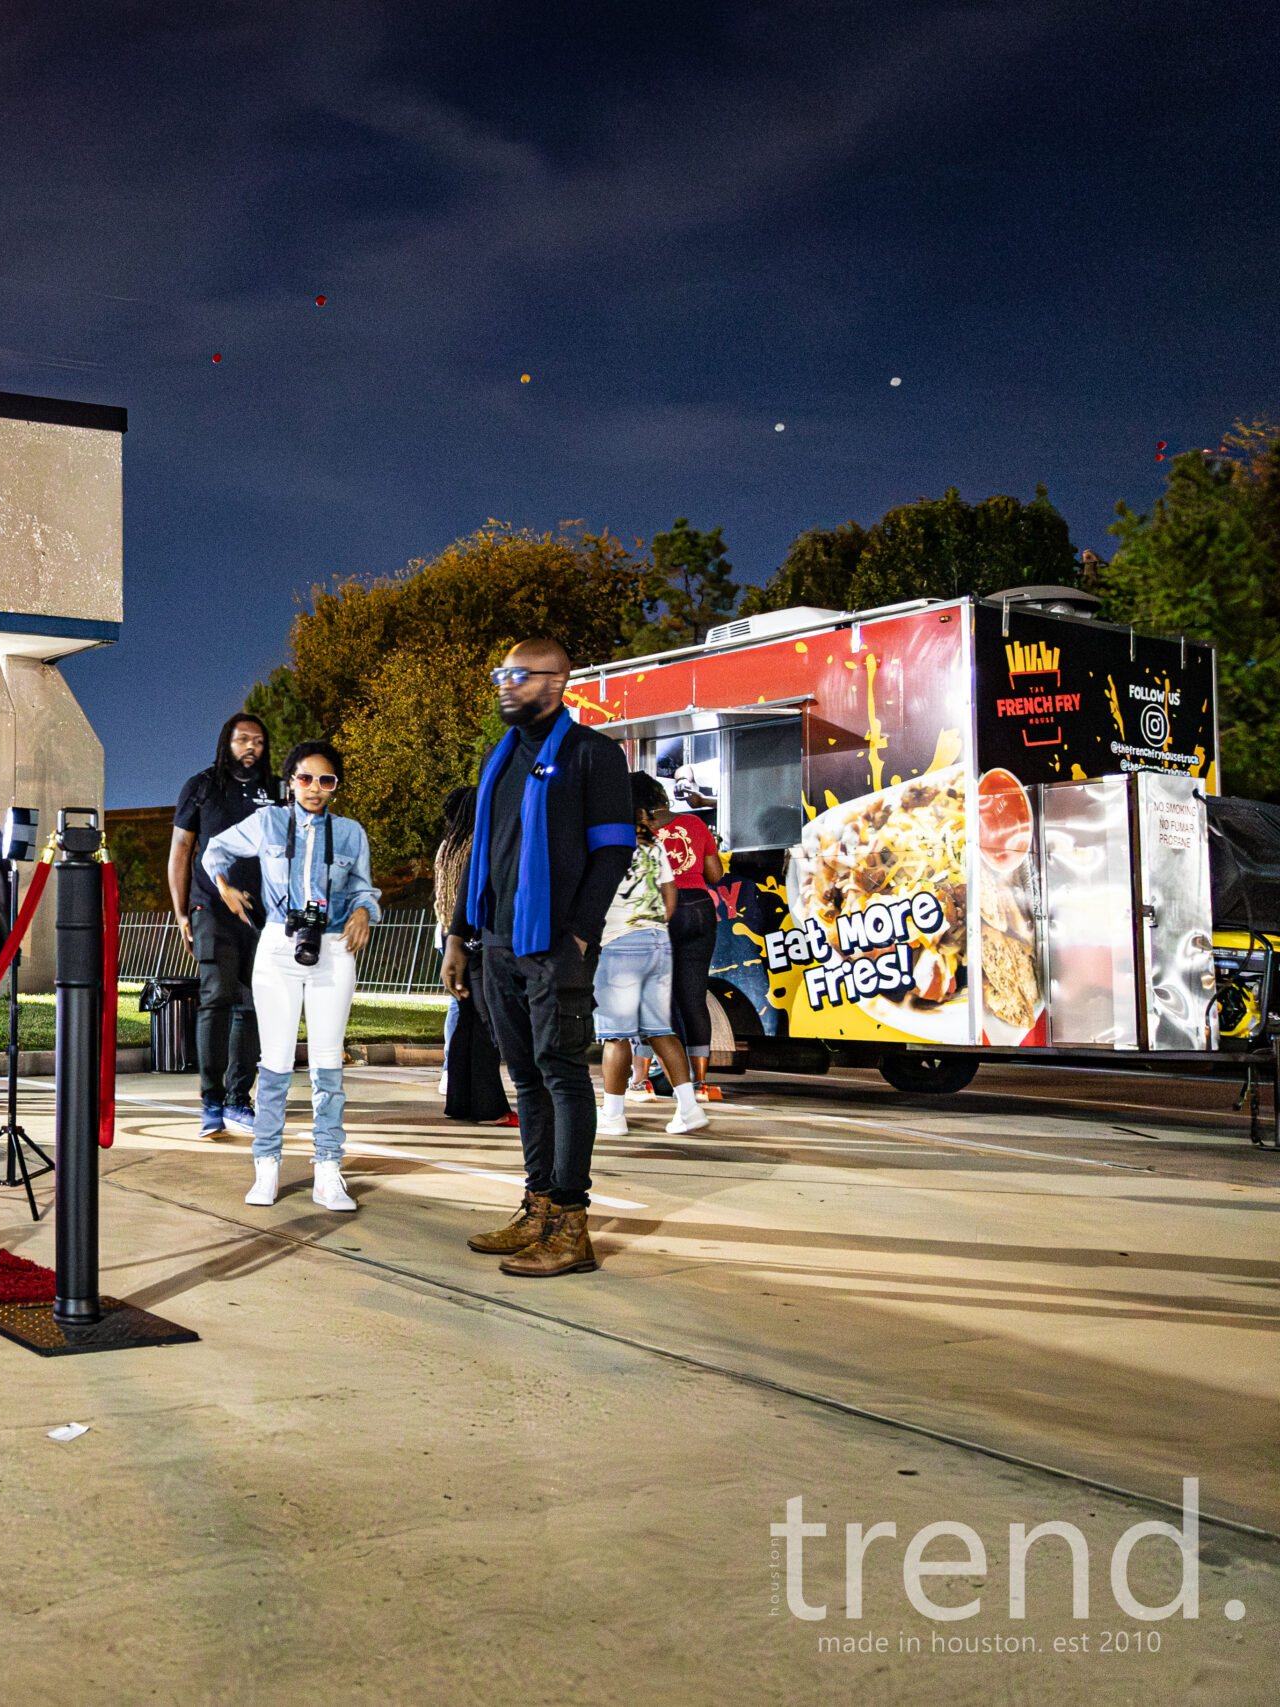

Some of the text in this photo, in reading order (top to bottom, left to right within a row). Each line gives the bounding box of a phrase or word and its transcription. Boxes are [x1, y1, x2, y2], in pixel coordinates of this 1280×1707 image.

[996, 693, 1081, 718] FRENCH FRY
[1129, 684, 1180, 706] FOLLOW US
[1153, 801, 1196, 817] NO SMOKING
[1159, 818, 1195, 834] NO FUMAR
[764, 892, 941, 970] Eat More
[804, 944, 912, 1007] Fries!
